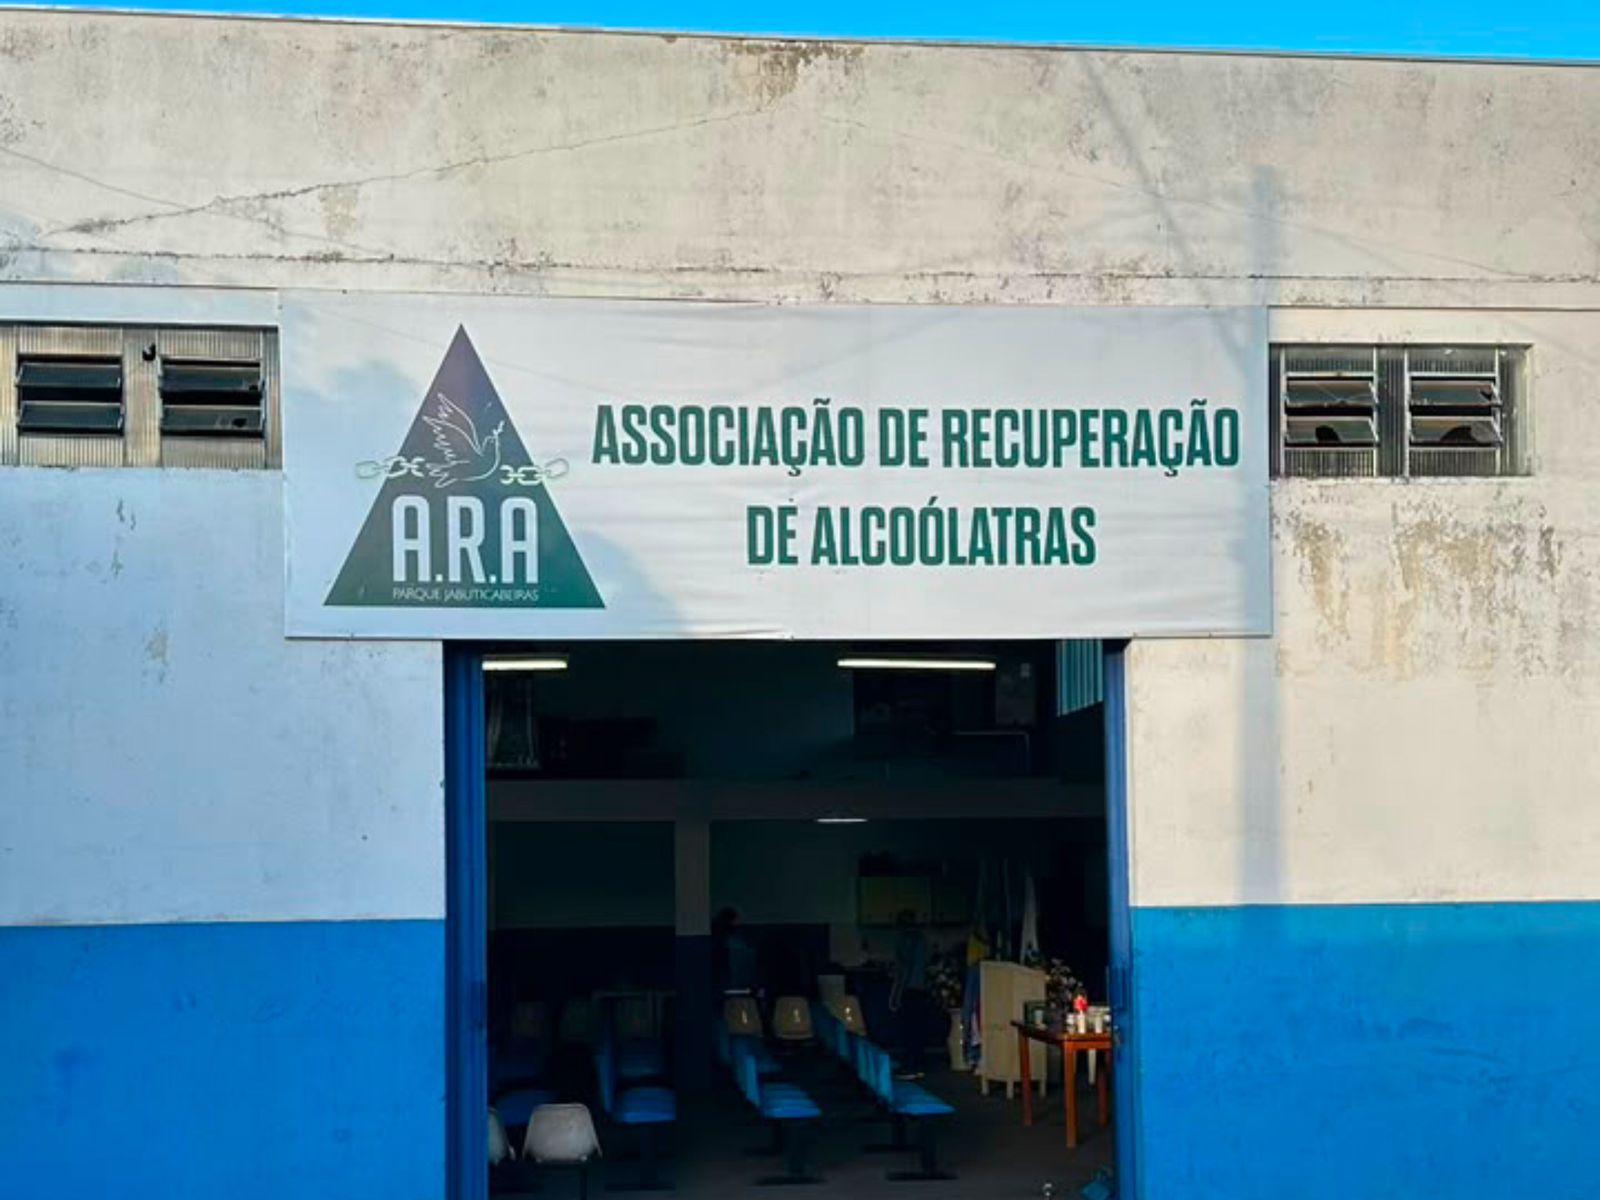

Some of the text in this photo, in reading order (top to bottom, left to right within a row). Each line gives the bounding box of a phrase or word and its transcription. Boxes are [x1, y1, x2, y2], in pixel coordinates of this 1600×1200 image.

[592, 398, 1240, 477] ASSOCIAÇÃO DE RECUPERAÇÃO
[392, 495, 539, 584] A.R.A
[746, 496, 1097, 566] DE ALCOÓLATRAS
[393, 587, 539, 602] PARQUE JABUTICABEIRAS
